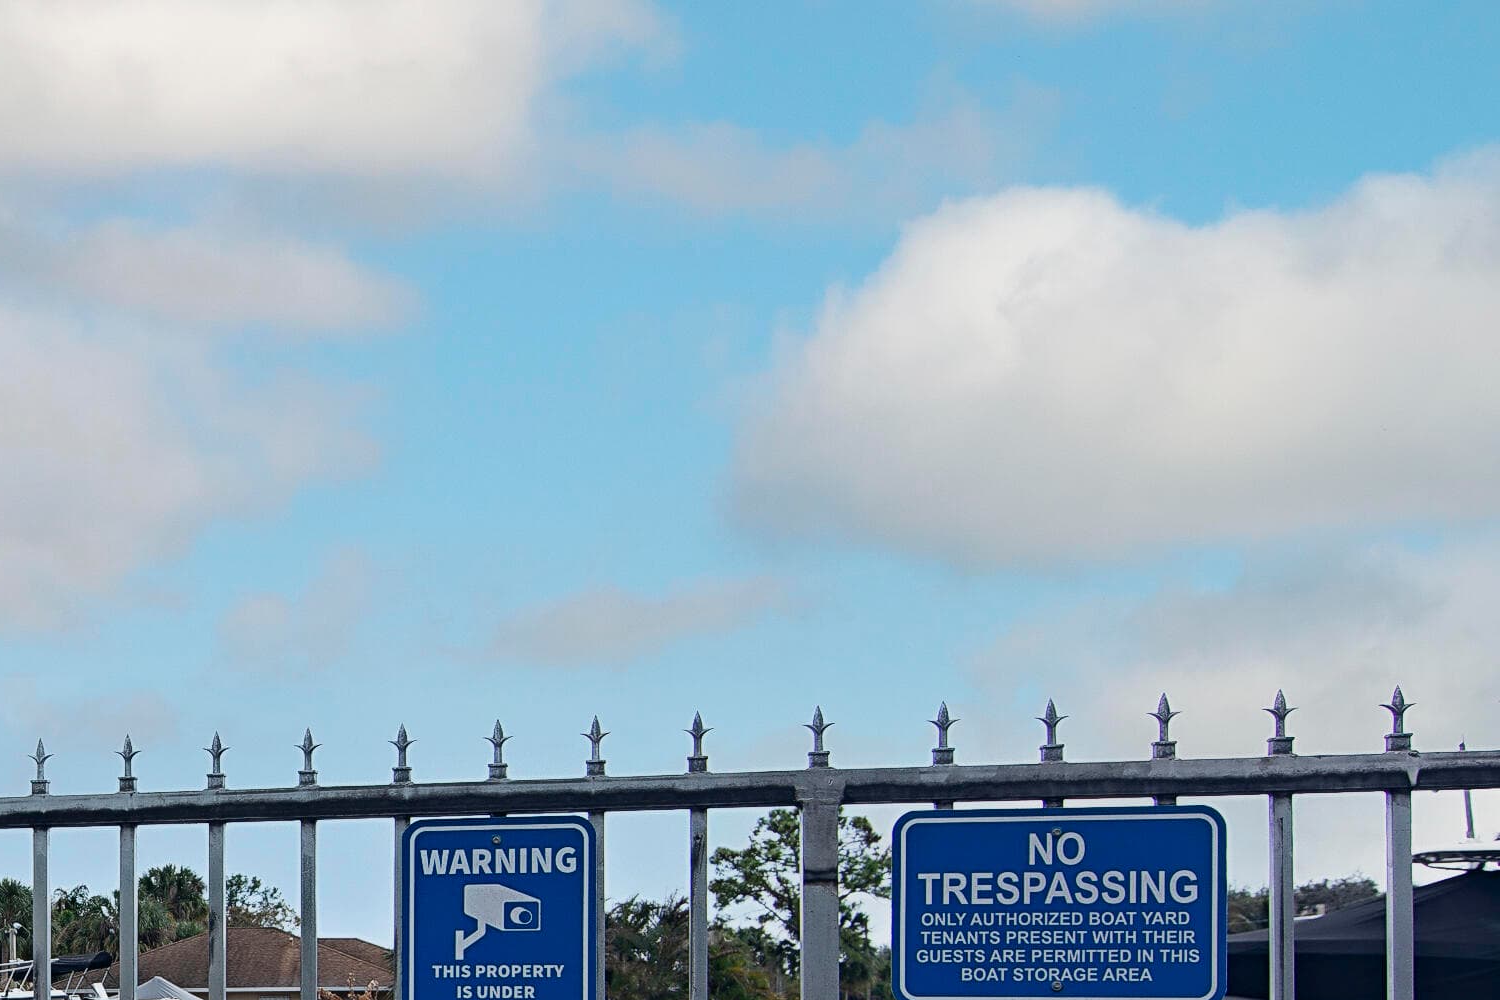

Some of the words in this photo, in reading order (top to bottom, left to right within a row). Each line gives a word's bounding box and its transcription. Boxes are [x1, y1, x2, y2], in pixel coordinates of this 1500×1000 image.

[1028, 832, 1085, 865] NO
[420, 847, 577, 875] WARNING
[917, 870, 1198, 905] TRESPASSING
[921, 912, 967, 926] ONLY
[970, 912, 1084, 926] AUTHORIZED
[1089, 912, 1137, 925] BOAT
[1141, 911, 1190, 925] YARD
[920, 931, 1001, 945] TENANTS
[1006, 931, 1088, 944] PRESENT
[1092, 930, 1137, 944] WITH
[1142, 930, 1196, 944] THEIR
[916, 949, 986, 963] GUESTS
[989, 949, 1026, 963] ARE
[1031, 949, 1132, 963] PERMITTED
[1137, 949, 1154, 963] IN
[1159, 949, 1200, 963] THIS
[432, 964, 471, 978] THIS
[475, 964, 565, 978] PROPERTY
[961, 968, 1008, 982] BOAT
[1012, 968, 1098, 982] STORAGE
[1102, 968, 1153, 982] AREA
[457, 985, 473, 999] IS
[476, 985, 535, 999] UNDER
